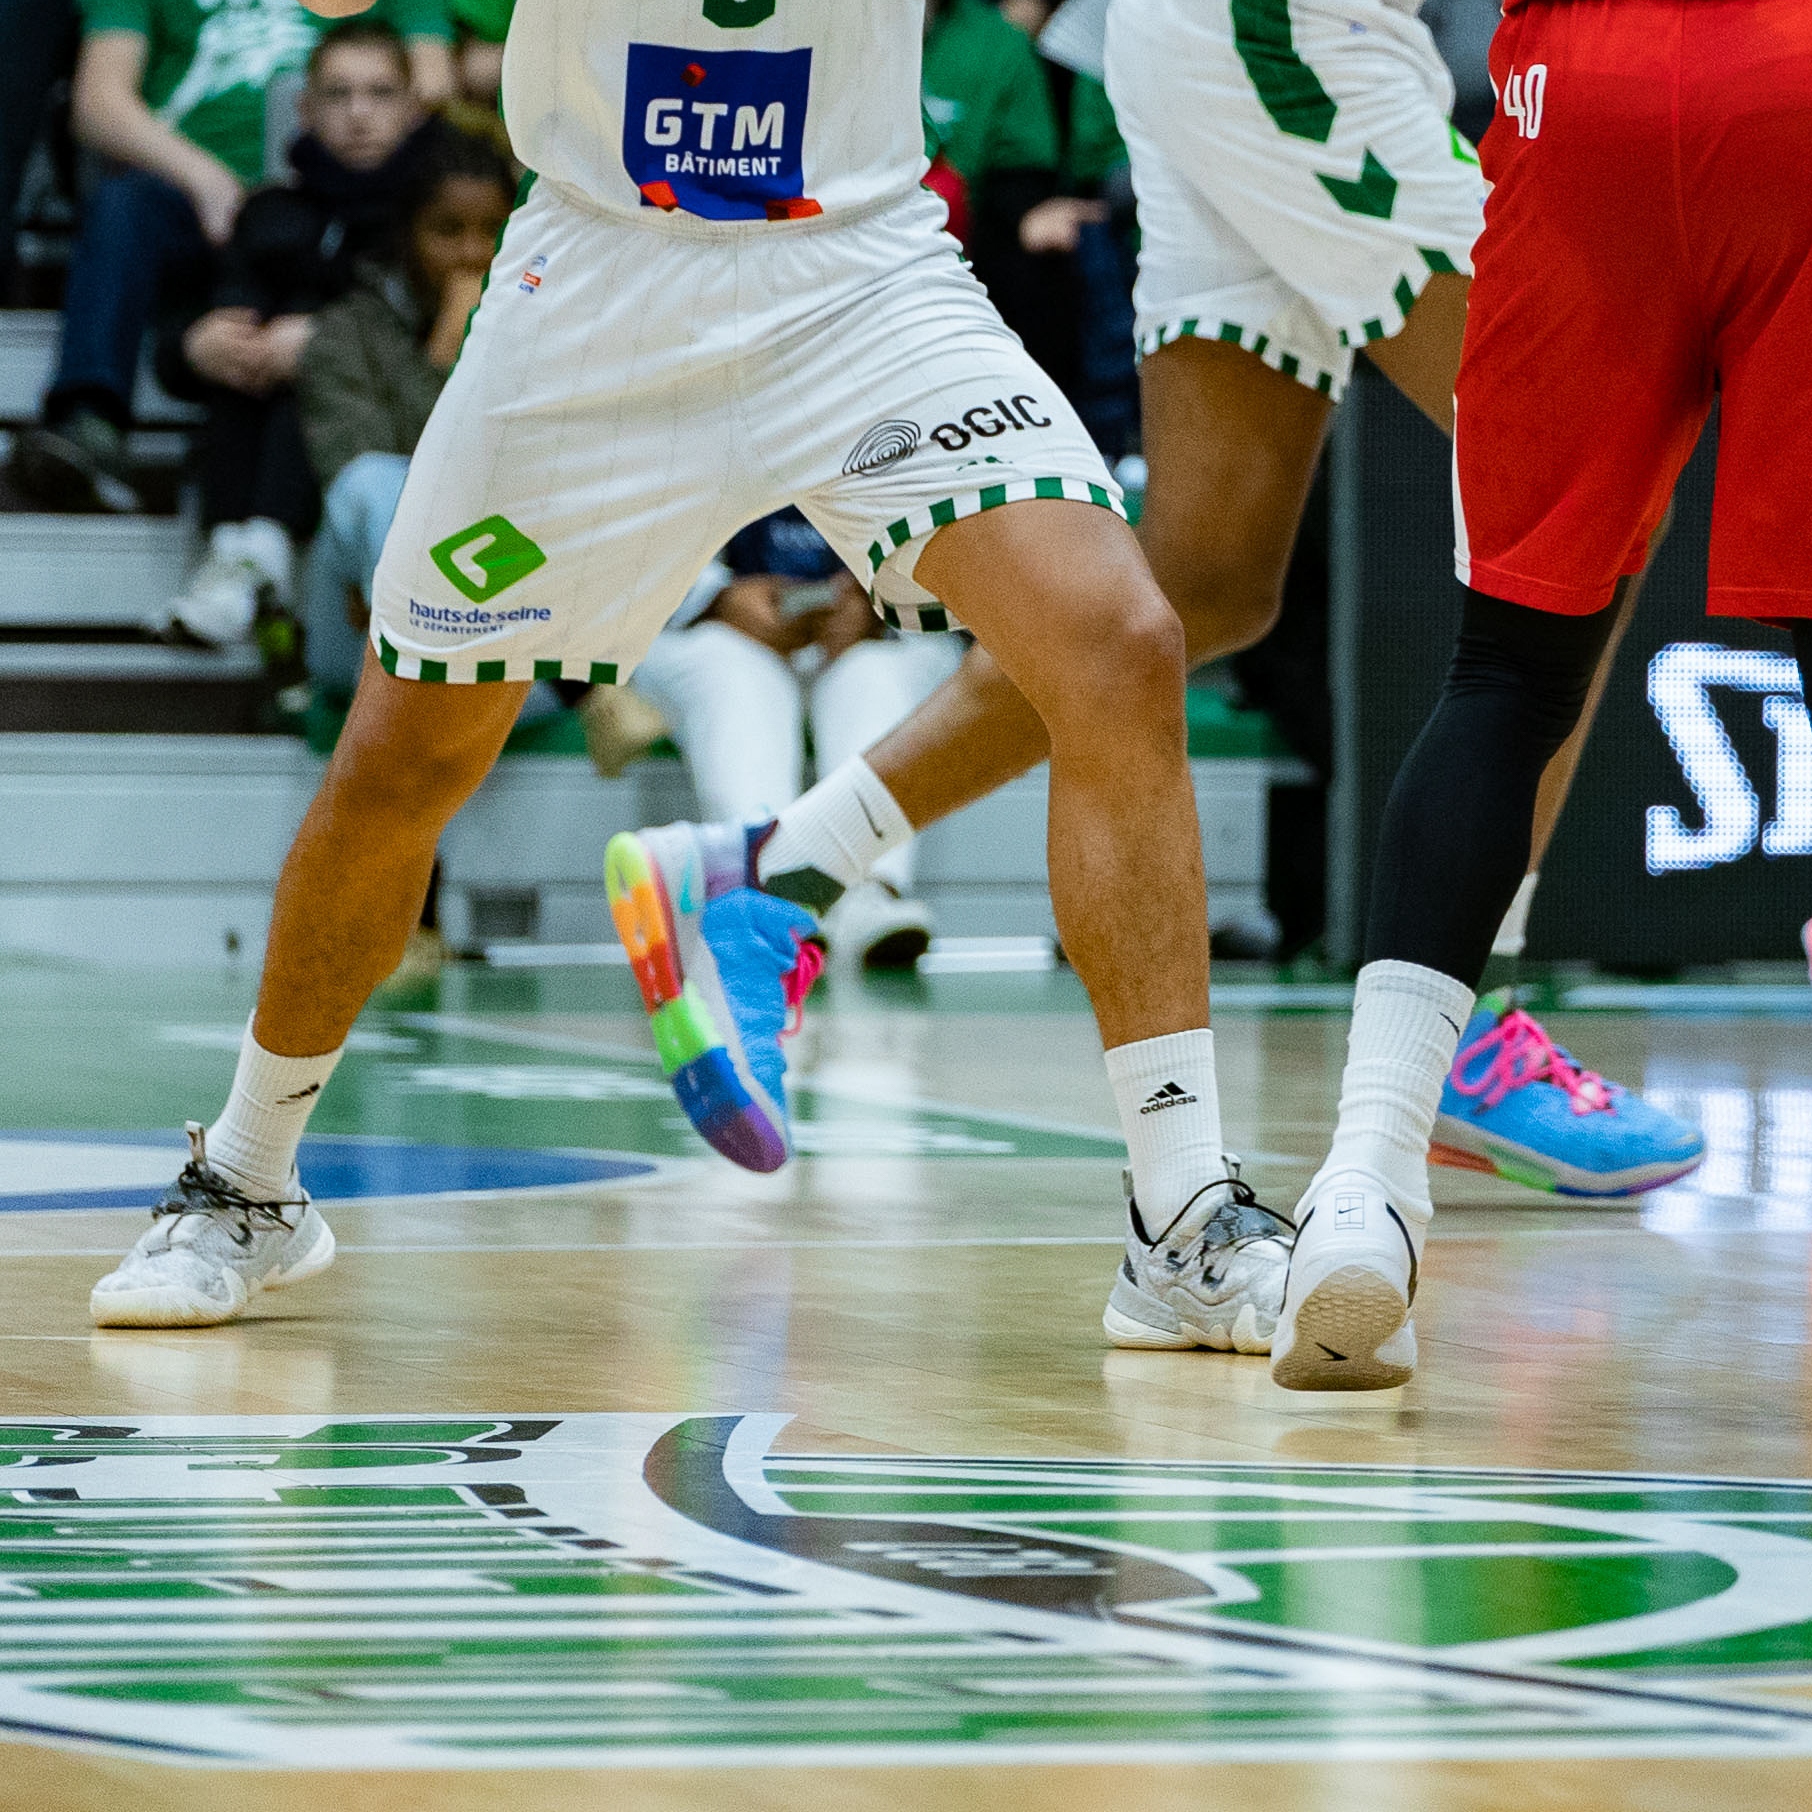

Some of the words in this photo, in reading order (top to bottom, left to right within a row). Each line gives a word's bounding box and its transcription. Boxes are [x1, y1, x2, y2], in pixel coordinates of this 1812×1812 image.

[1503, 63, 1548, 140] 40
[645, 98, 785, 151] GTM
[665, 150, 782, 176] BÂTIMENT
[1140, 1095, 1198, 1114] adidas
